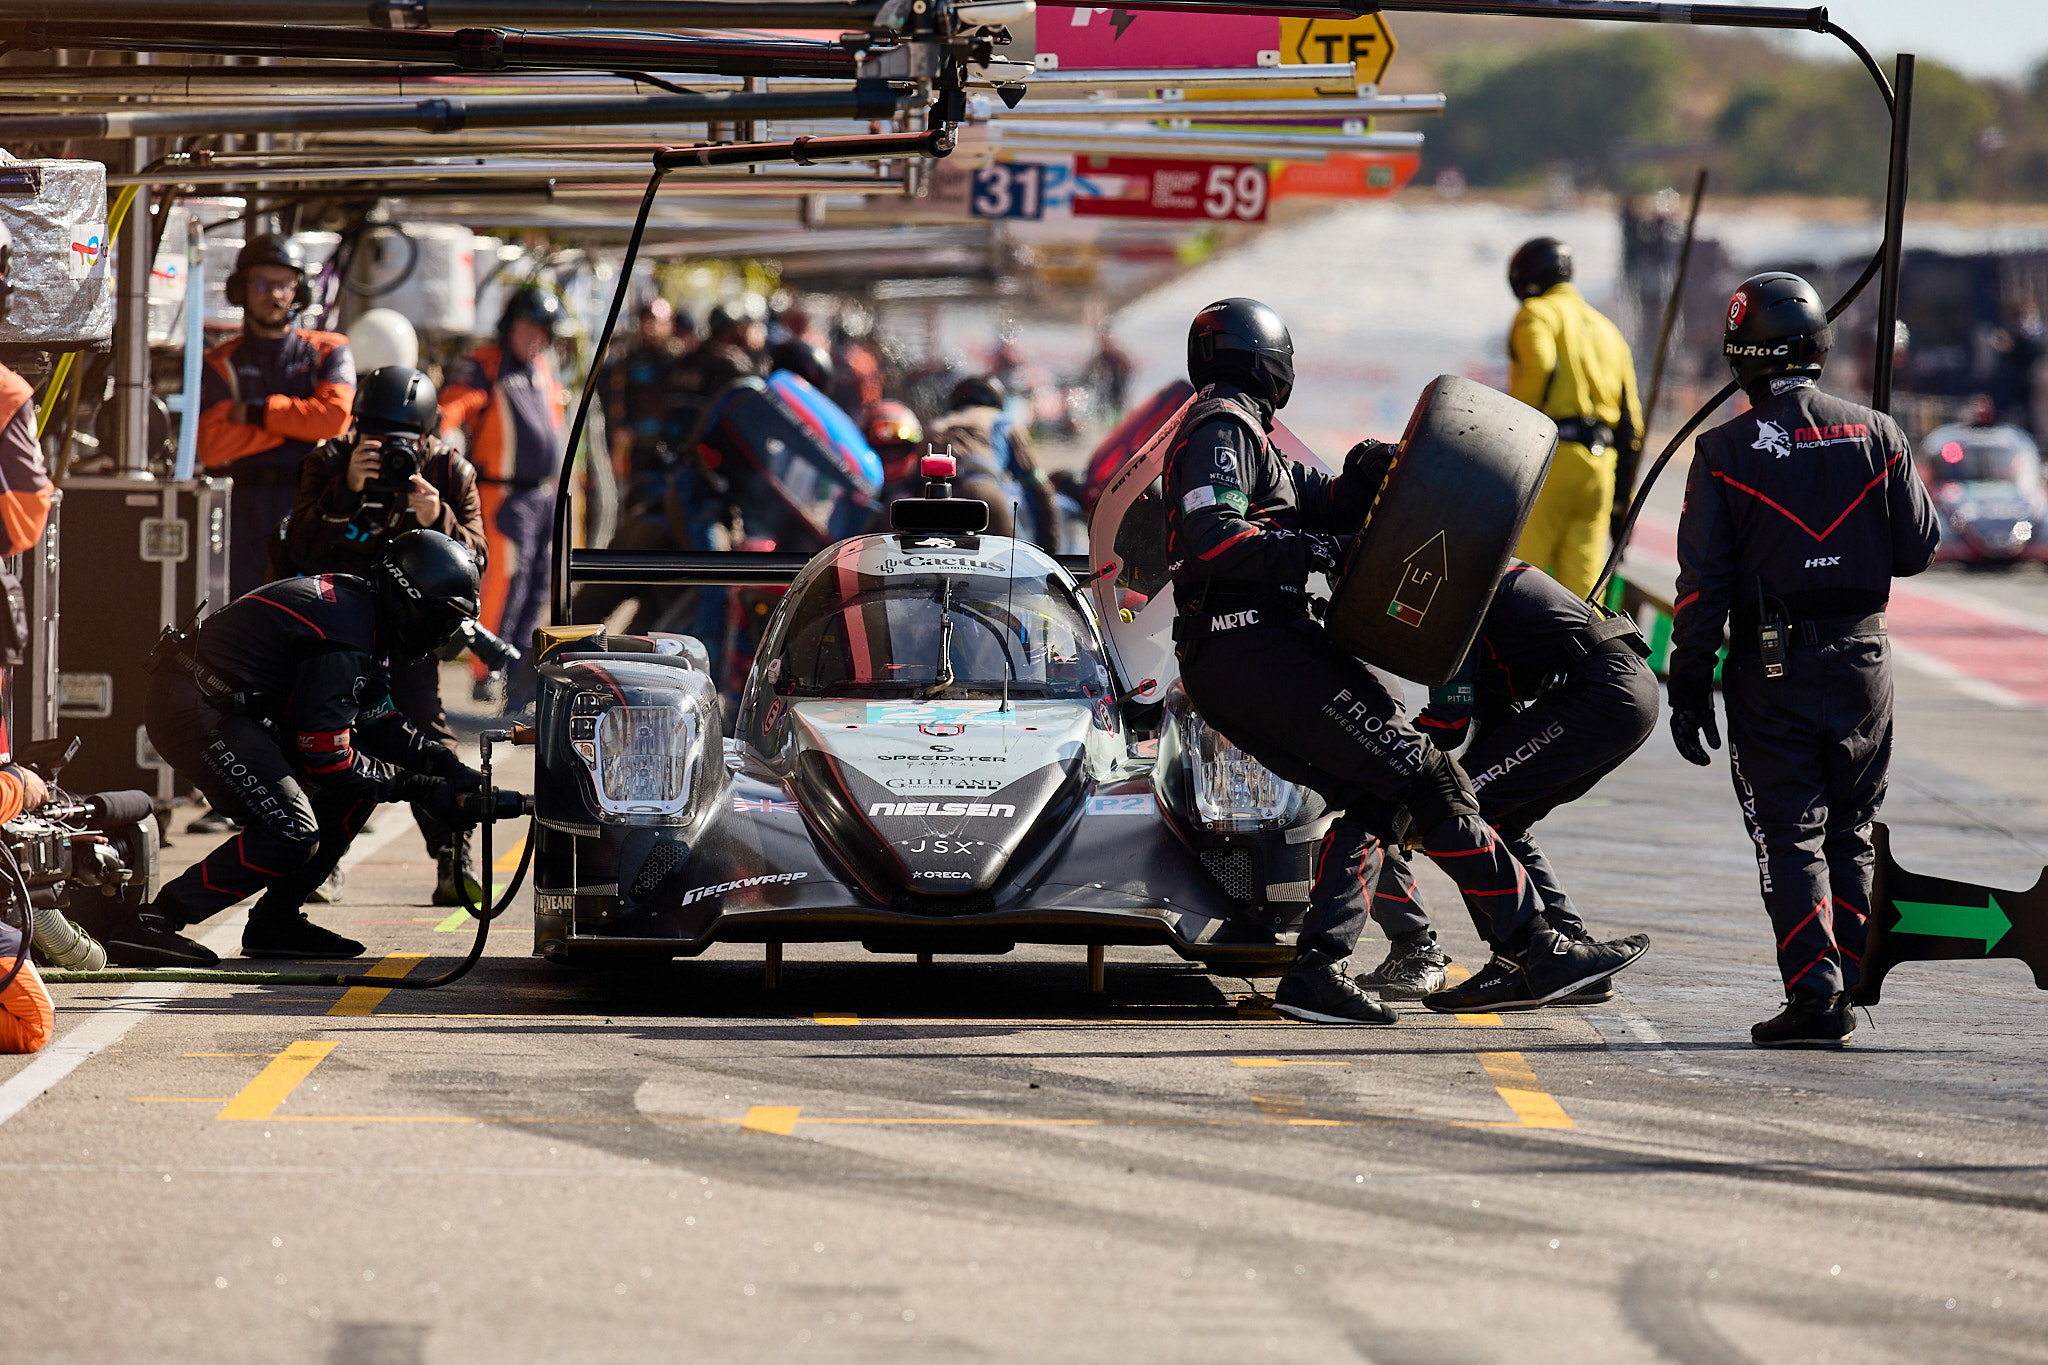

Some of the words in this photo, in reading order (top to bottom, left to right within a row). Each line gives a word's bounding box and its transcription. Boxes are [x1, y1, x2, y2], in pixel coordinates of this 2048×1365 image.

[1314, 35, 1376, 68] TF
[986, 164, 1038, 218] 31
[1203, 165, 1266, 220] 59
[1726, 343, 1788, 356] RUROC
[1795, 424, 1867, 442] NIELSEN
[1797, 439, 1831, 449] RACING
[904, 556, 1006, 572] Cactus
[1804, 555, 1842, 568] HRX
[383, 555, 421, 600] UROC
[1411, 567, 1433, 585] LF
[1211, 609, 1260, 632] MRTC
[1447, 695, 1462, 703] PIT
[1333, 688, 1424, 773] FROSFE
[877, 755, 1007, 763] SPEEDSTER
[886, 778, 1002, 789] GILLILAND
[868, 802, 1016, 818] NIELSEN
[1095, 797, 1145, 811] P2
[910, 839, 973, 855] JSX
[923, 871, 972, 880] ORECA
